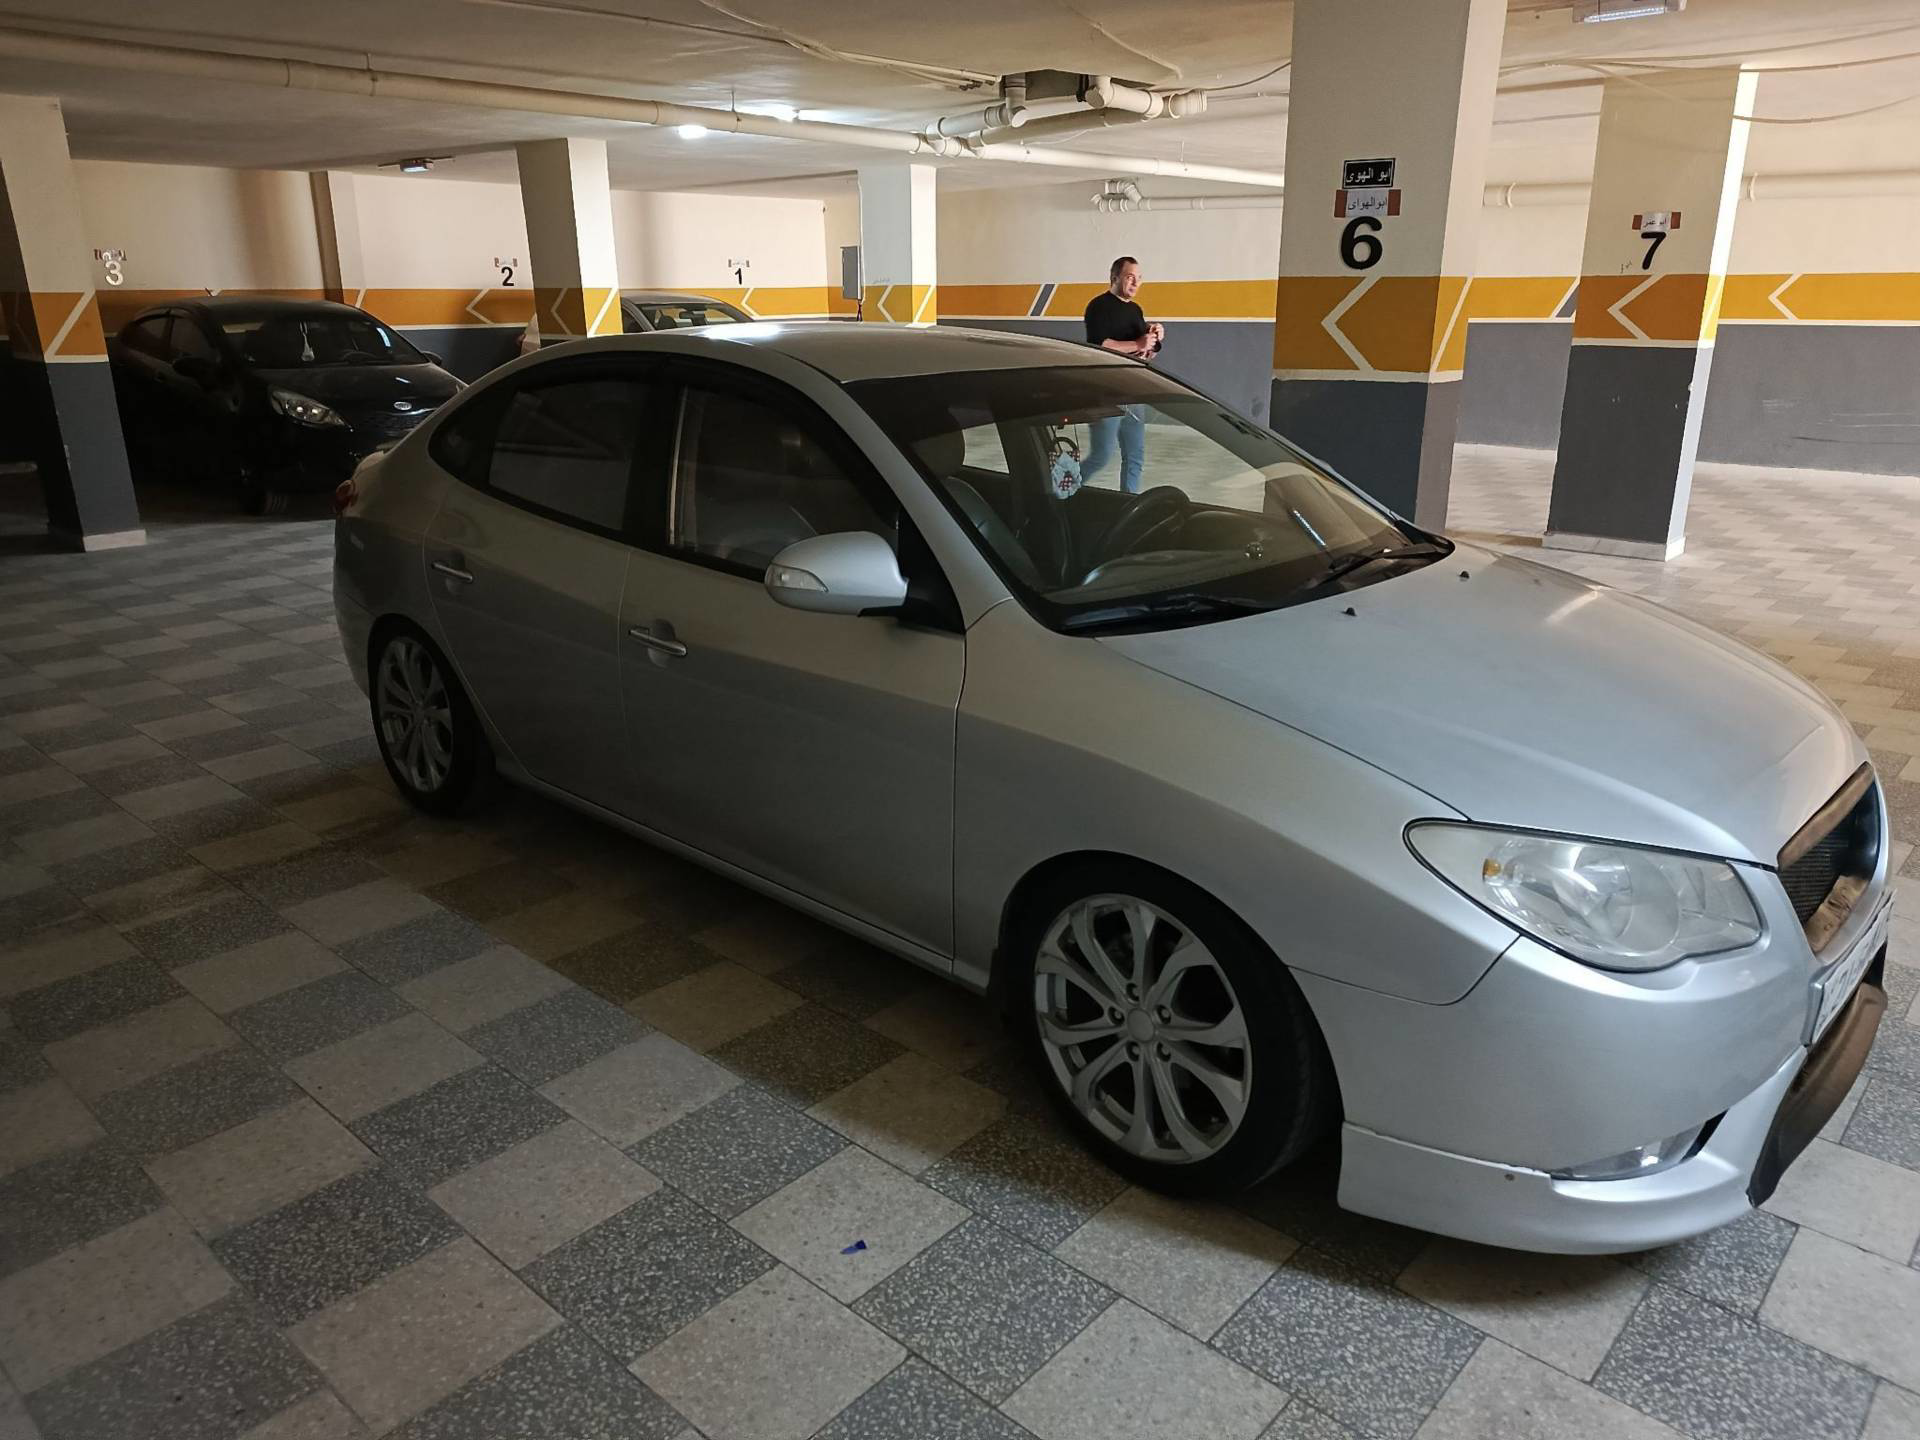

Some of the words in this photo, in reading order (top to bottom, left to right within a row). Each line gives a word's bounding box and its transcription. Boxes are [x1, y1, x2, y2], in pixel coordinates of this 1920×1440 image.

[1340, 215, 1383, 270] 6
[1641, 231, 1667, 270] 7
[105, 260, 124, 286] 3
[501, 265, 515, 287] 2
[734, 267, 743, 286] 1
